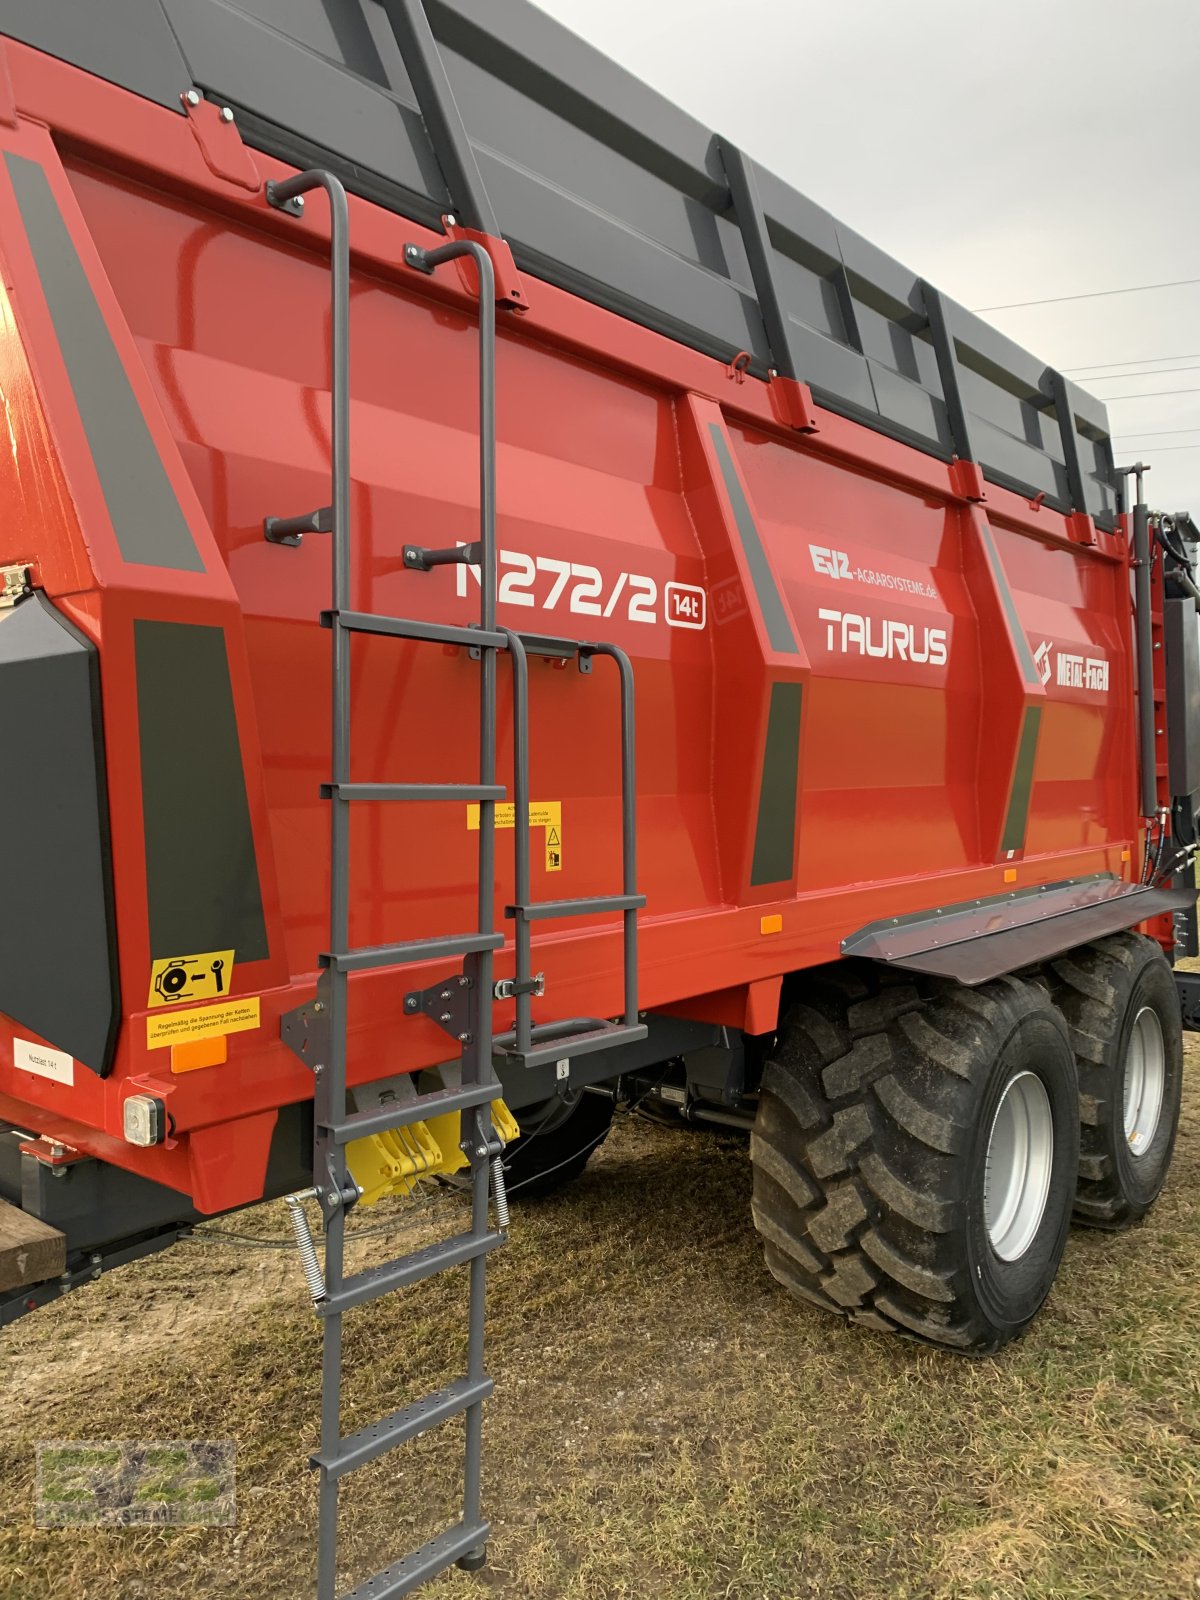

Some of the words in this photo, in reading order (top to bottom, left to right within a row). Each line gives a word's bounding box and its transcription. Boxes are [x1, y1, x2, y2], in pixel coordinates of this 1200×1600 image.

[673, 594, 699, 618] 14t
[819, 608, 947, 666] TAURUS
[150, 1029, 180, 1038] überprüfen
[191, 1021, 219, 1031] gegebenen
[229, 1013, 257, 1022] nachziehen
[157, 1019, 189, 1030] Regelmäßig
[198, 1013, 224, 1022] Spannung
